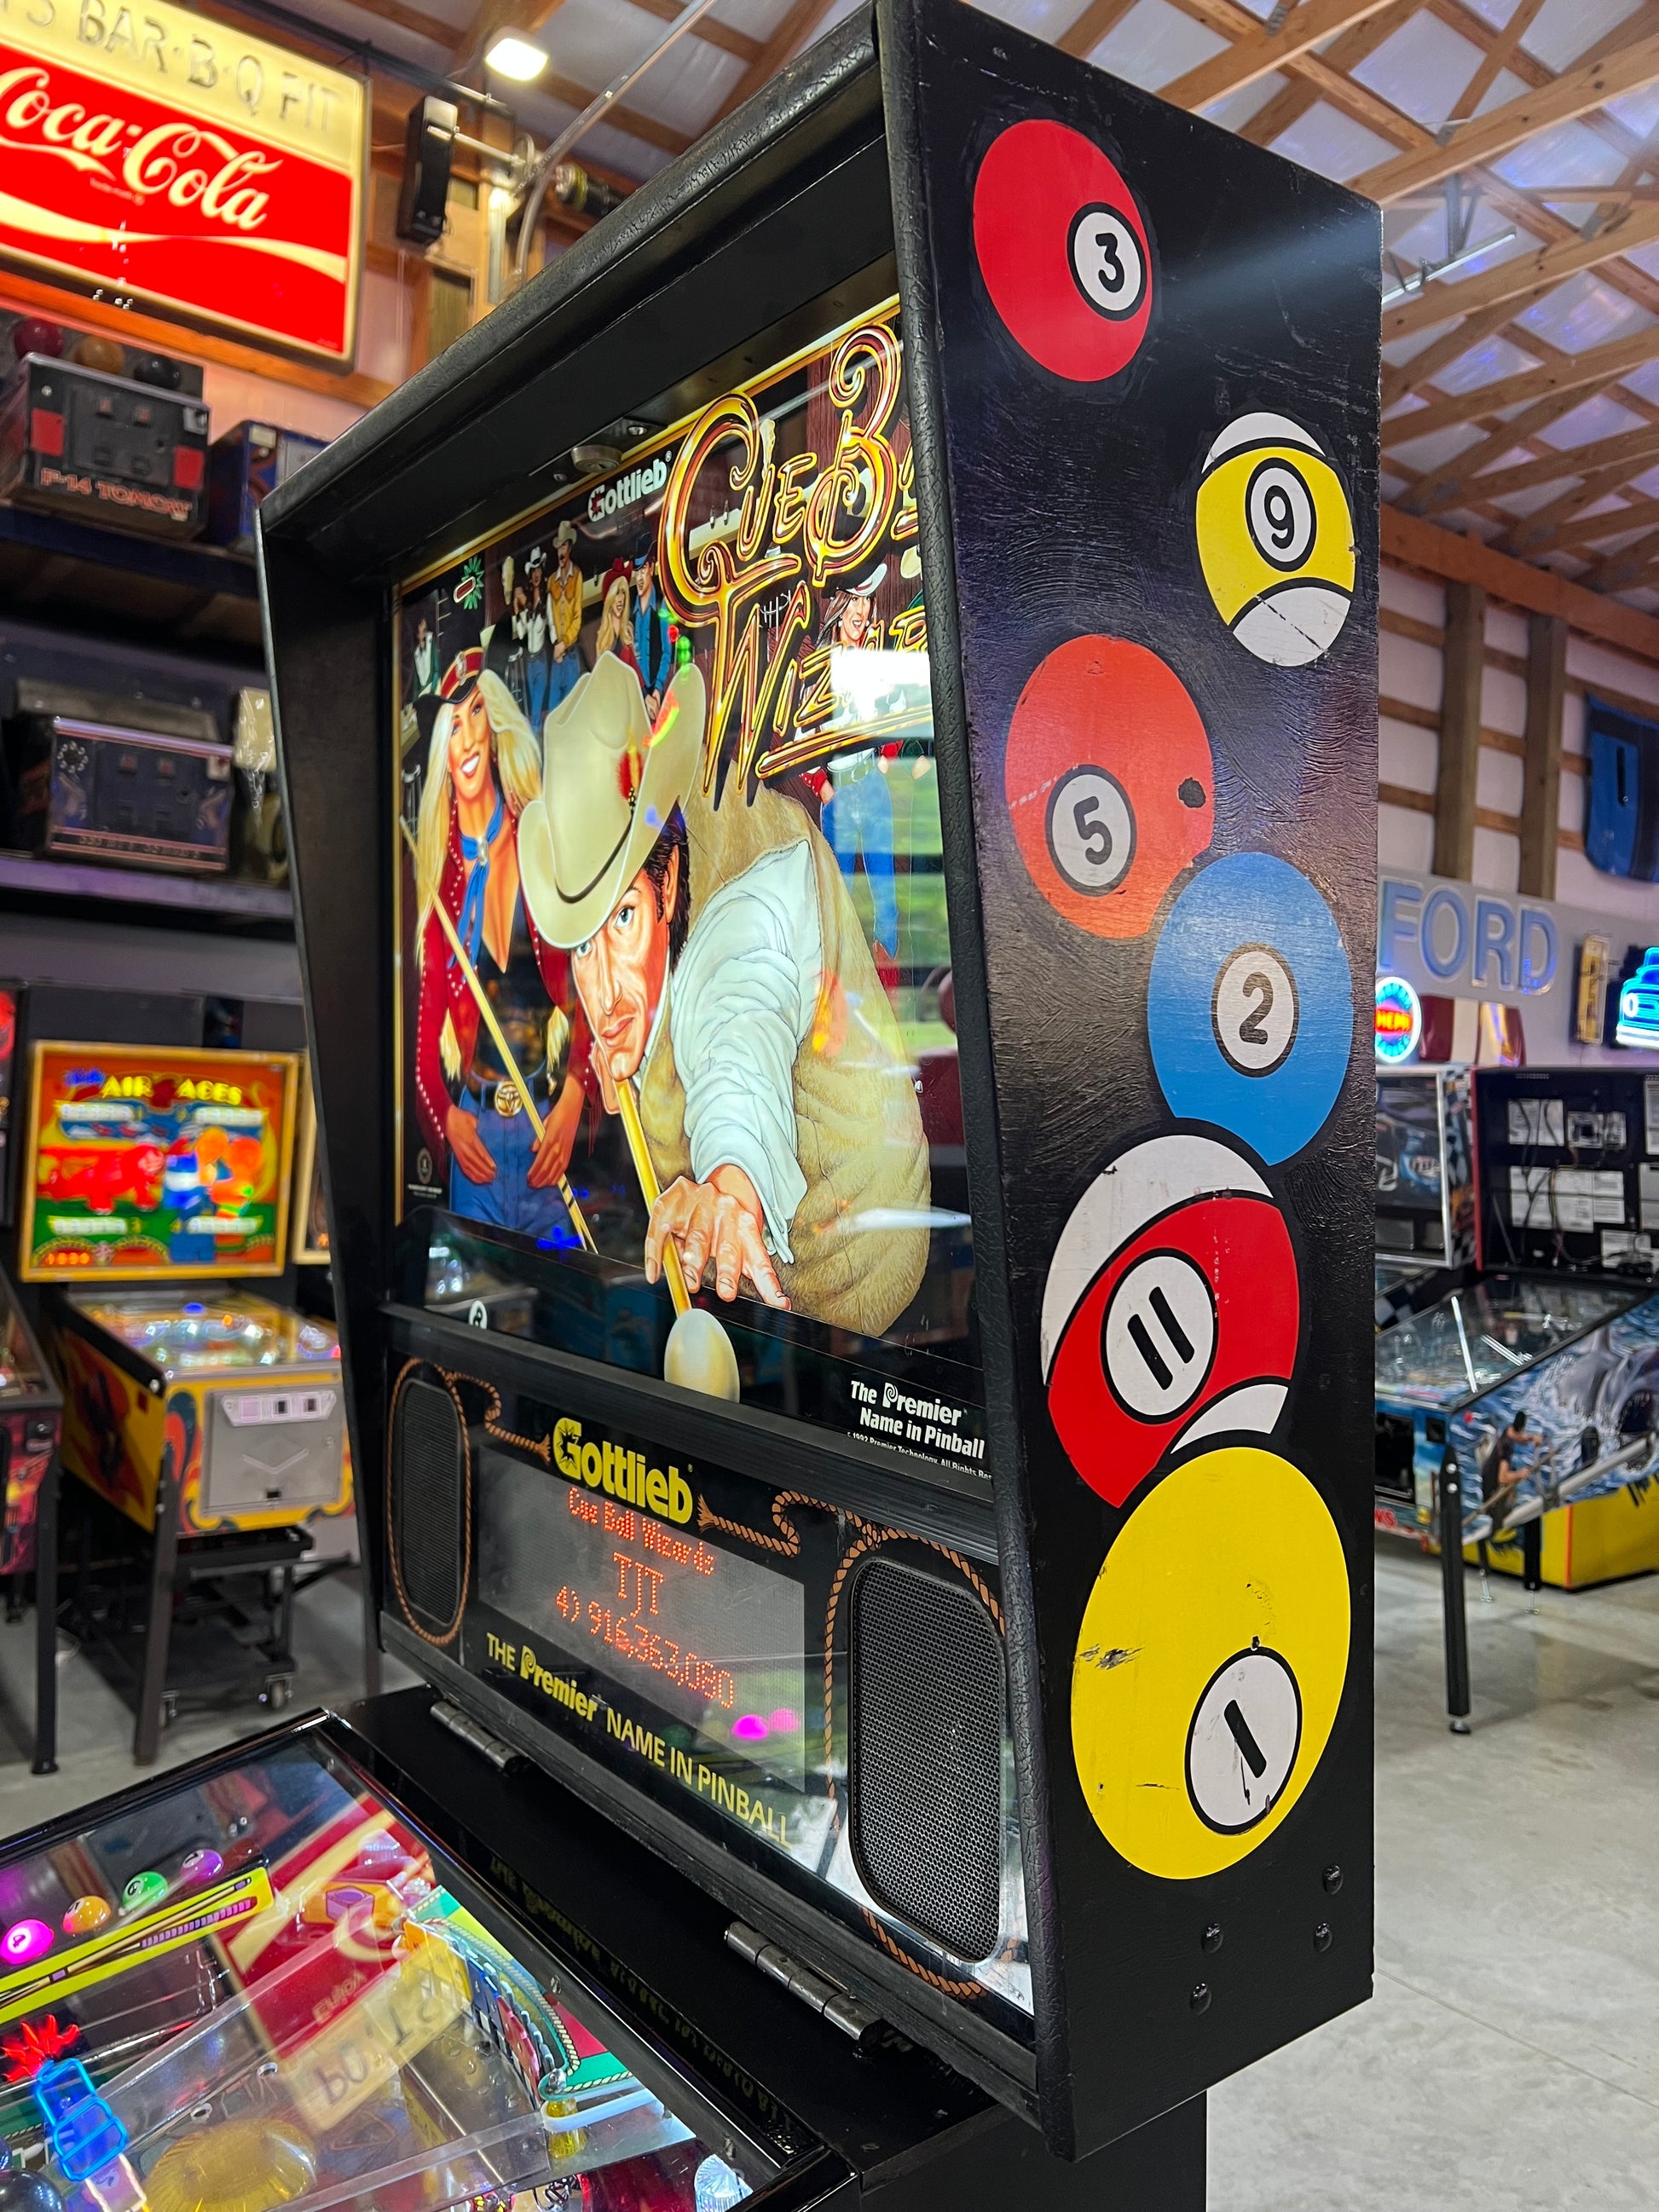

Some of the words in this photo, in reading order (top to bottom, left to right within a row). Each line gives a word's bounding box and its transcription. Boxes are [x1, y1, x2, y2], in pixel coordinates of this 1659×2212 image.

[1095, 232, 1126, 293] 3
[41, 467, 92, 495] F-14
[587, 459, 668, 523] Gottlieb
[1263, 483, 1295, 550] 9
[1072, 794, 1113, 865] 5
[1378, 877, 1559, 996] FORD
[1237, 971, 1275, 1046] 2
[101, 1074, 154, 1099] AIR
[175, 1077, 243, 1106] ACES
[1126, 1285, 1195, 1391] 11
[851, 1380, 878, 1405] The
[882, 1382, 962, 1427] Premier
[859, 1406, 904, 1436] Name
[906, 1419, 922, 1442] in
[923, 1424, 986, 1459] Pinball
[552, 1417, 693, 1525] Gottlieb
[486, 1632, 516, 1672] THE
[519, 1644, 598, 1722] Premier
[606, 1707, 666, 1768] NAME
[670, 1746, 693, 1786] IN
[697, 1763, 794, 1851] PINBALL
[1223, 1698, 1268, 1779] 1
